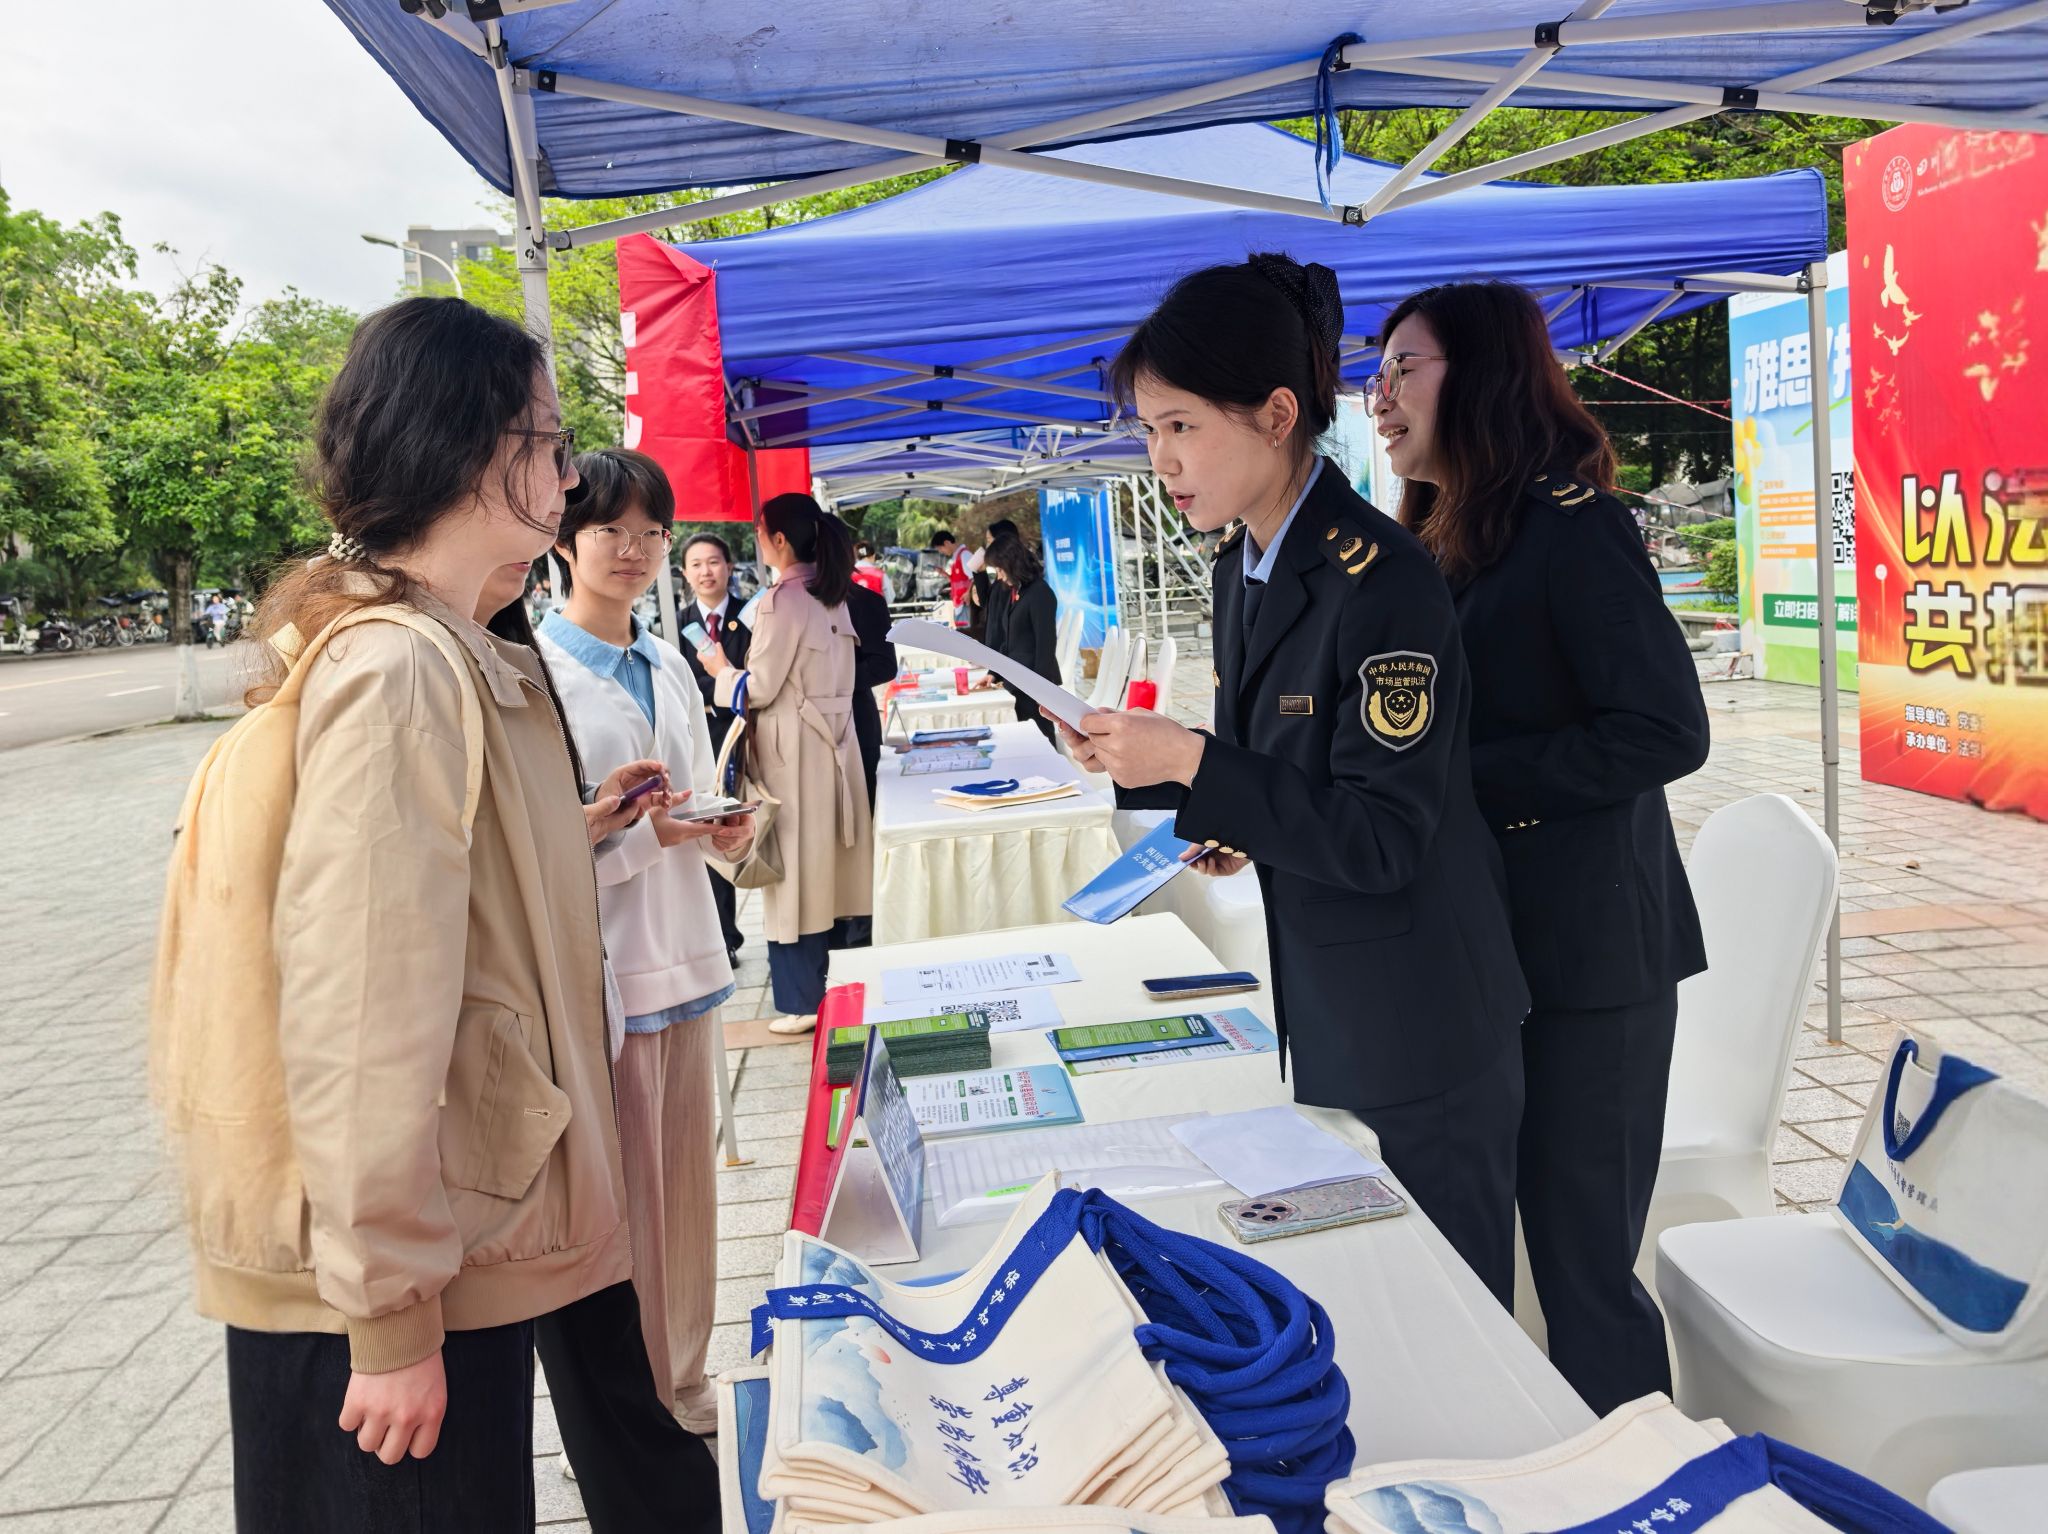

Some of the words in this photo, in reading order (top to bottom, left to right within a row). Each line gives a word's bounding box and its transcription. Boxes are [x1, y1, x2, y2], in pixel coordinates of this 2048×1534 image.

[1774, 600, 1857, 622] 立即扫码解
[1368, 661, 1431, 676] 中华人民共和国
[1375, 676, 1426, 687] 市场监管执法
